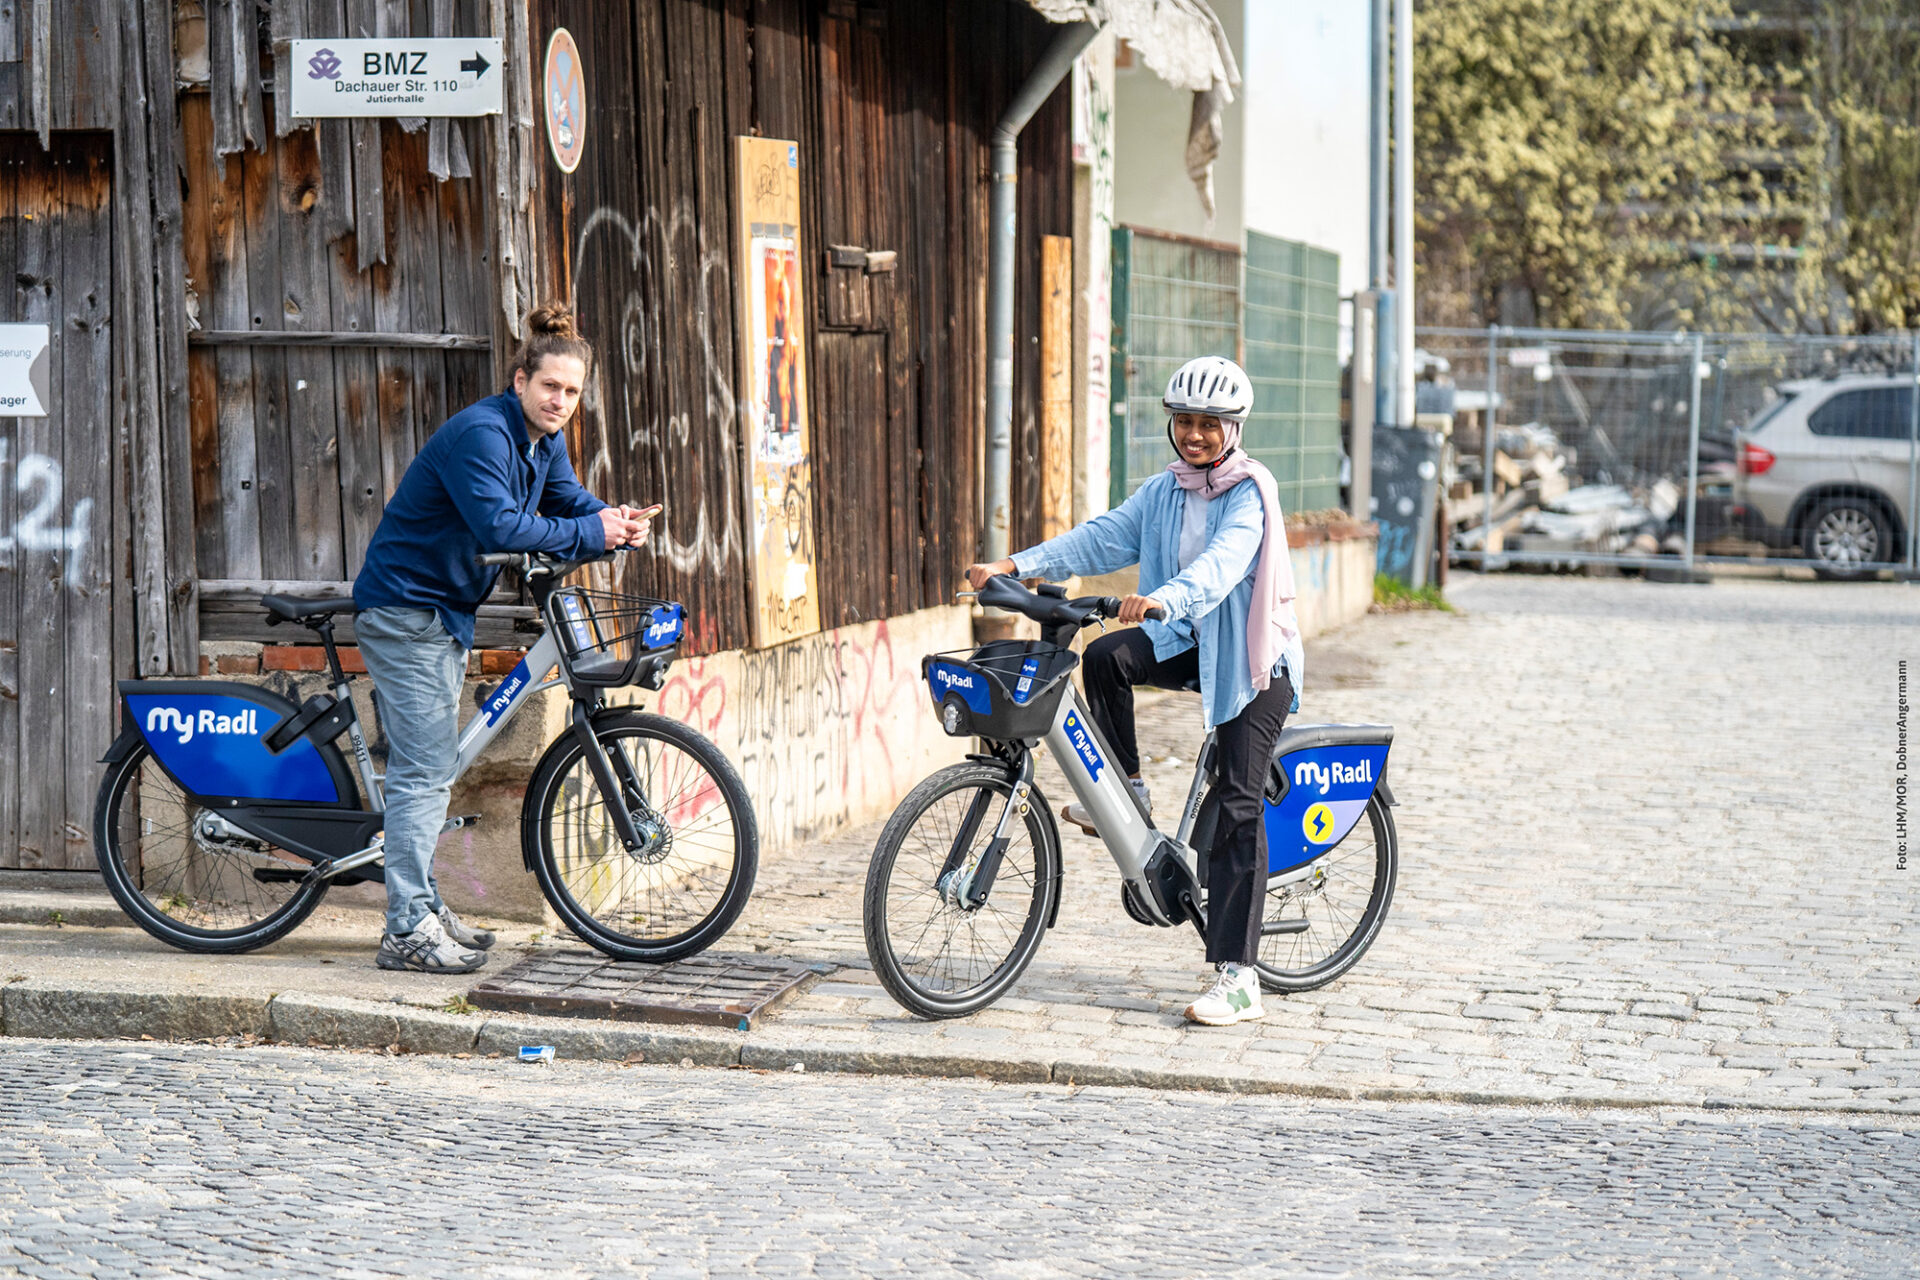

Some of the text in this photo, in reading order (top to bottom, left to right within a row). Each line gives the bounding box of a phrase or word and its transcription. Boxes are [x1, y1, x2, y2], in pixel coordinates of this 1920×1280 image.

[363, 52, 428, 75] BMZ
[335, 80, 458, 92] Dachauer Str. 110
[366, 94, 424, 103] Jutierhalle
[352, 734, 367, 763] 99411
[1226, 988, 1251, 1013] N
